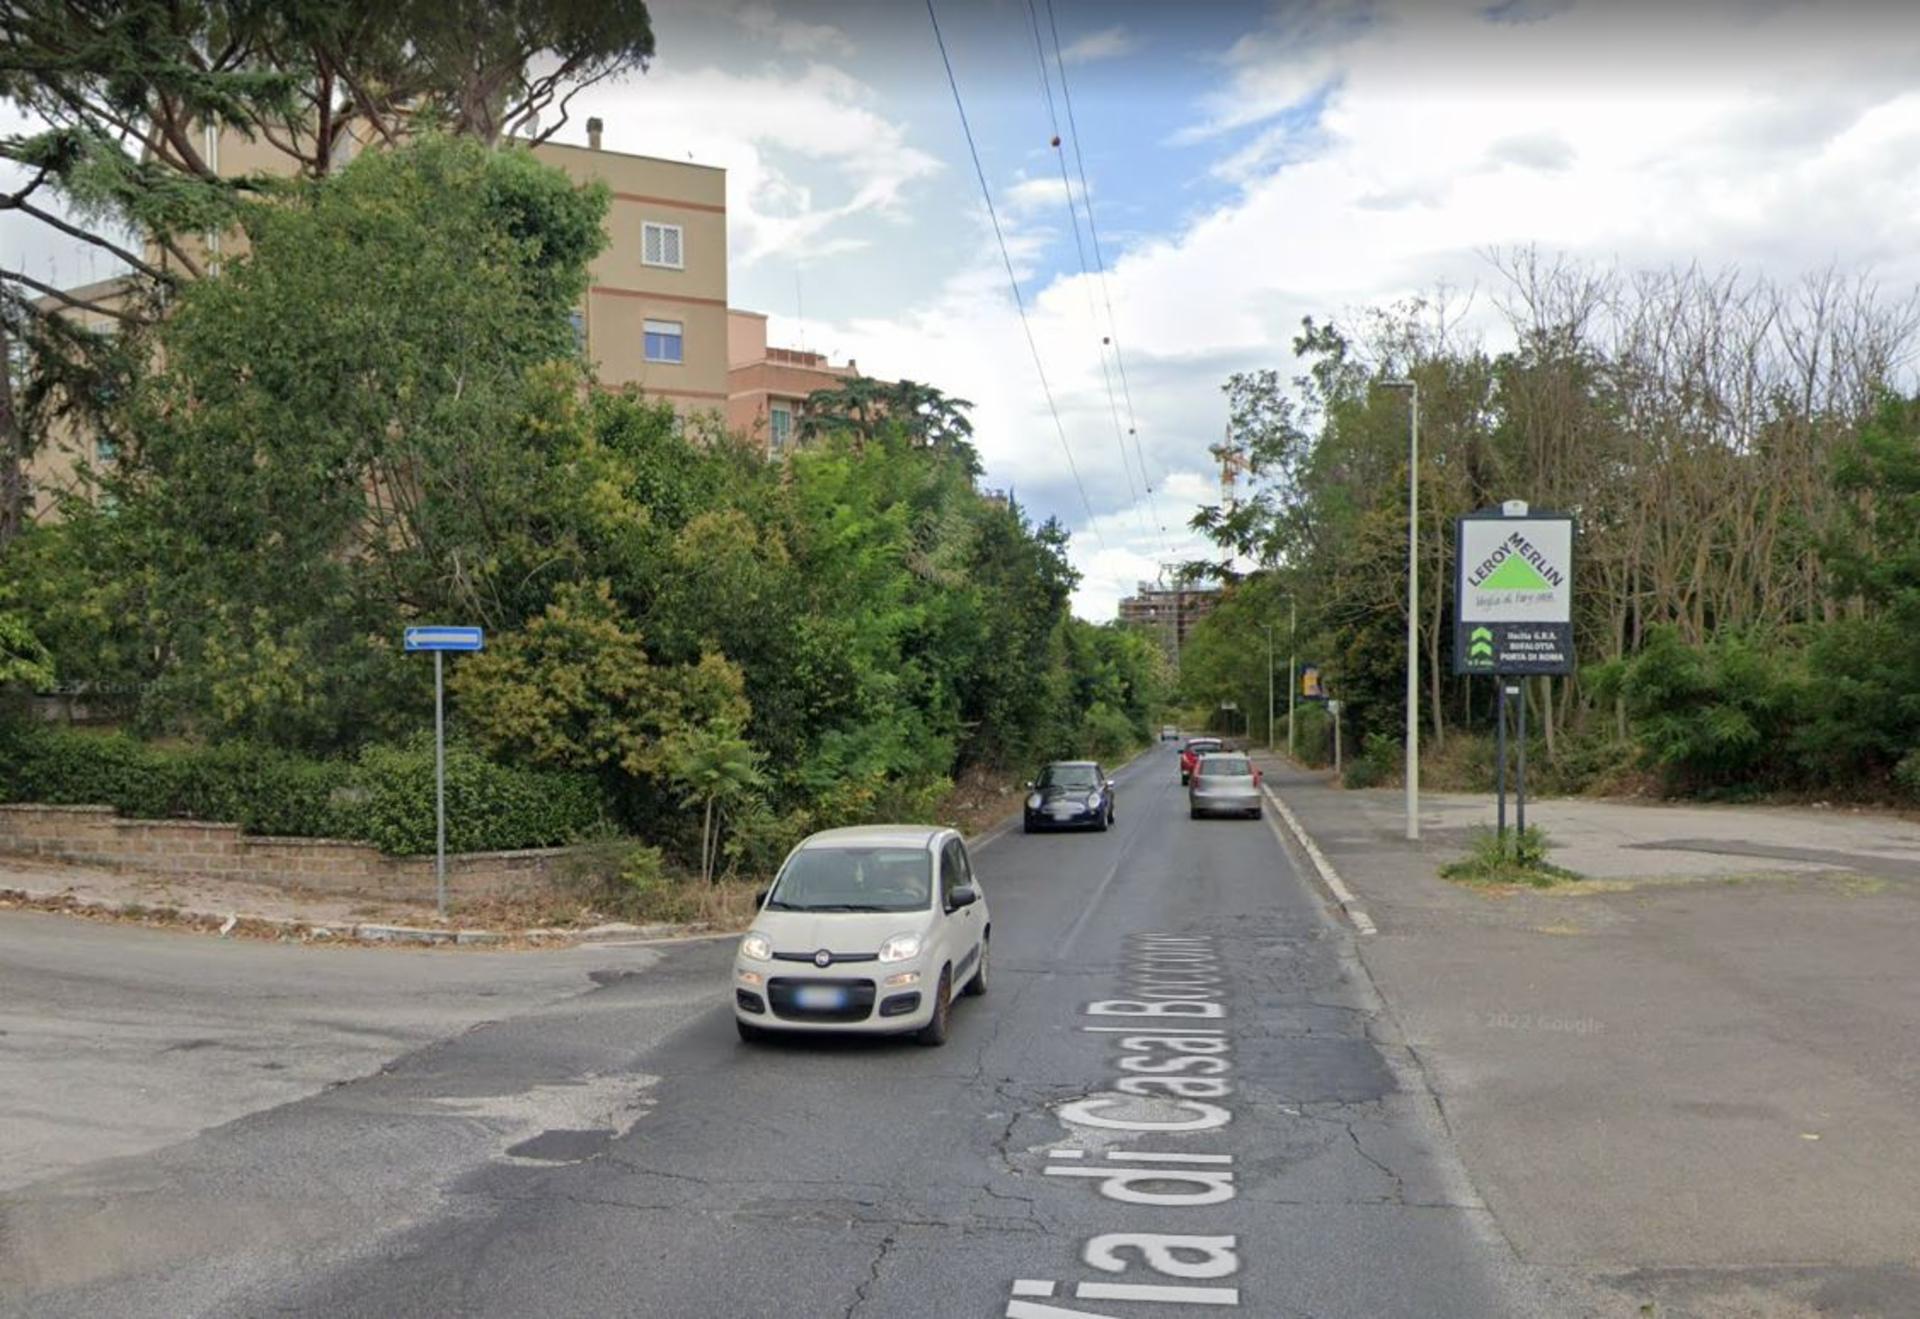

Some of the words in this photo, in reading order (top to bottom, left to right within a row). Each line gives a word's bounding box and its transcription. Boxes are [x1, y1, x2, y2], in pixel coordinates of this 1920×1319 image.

[1468, 541, 1512, 587] LEROY
[1508, 532, 1564, 587] MERLIN
[1500, 653, 1527, 661] PORTA
[1527, 653, 1538, 661] DI
[1538, 653, 1565, 661] ROMA
